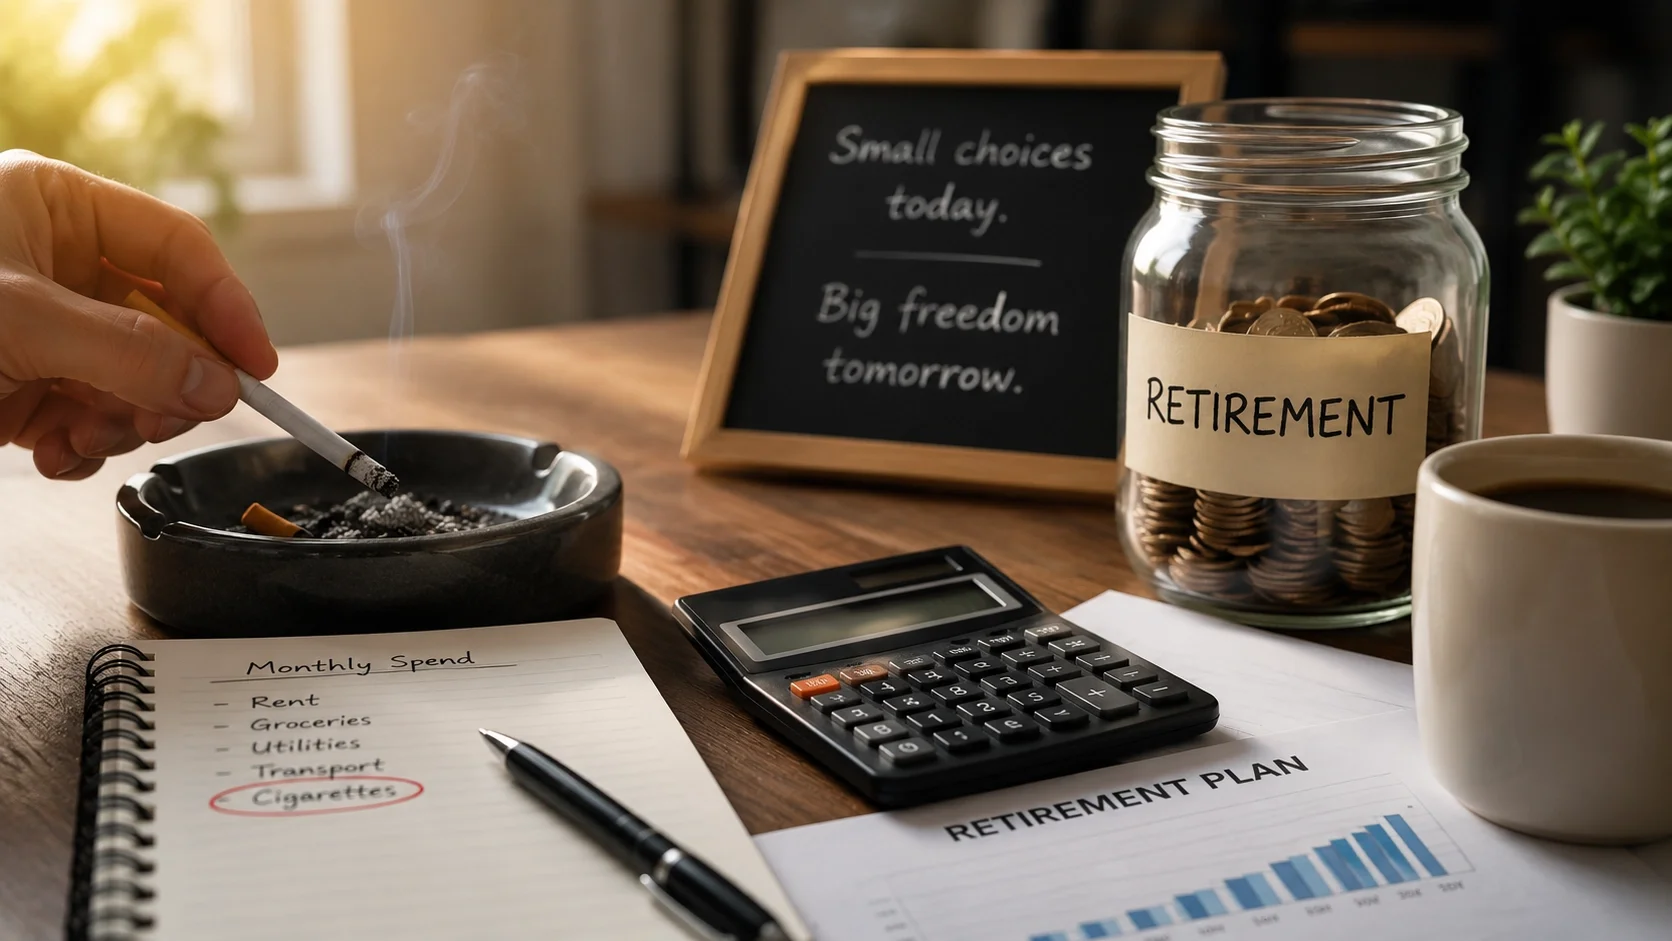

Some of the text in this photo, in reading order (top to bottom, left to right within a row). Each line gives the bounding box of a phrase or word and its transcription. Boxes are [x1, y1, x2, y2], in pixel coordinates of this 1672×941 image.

[828, 124, 1094, 171] Small choices
[886, 181, 1008, 237] today.
[816, 281, 1060, 338] Big freedom
[822, 346, 1023, 394] tomorrow.
[1147, 376, 1406, 438] RETIREMENT
[246, 651, 475, 676] Monthly Spend
[251, 694, 320, 709] Rent
[250, 715, 372, 732] Groceries
[252, 737, 361, 755] Utilities
[253, 759, 385, 780] Transport
[252, 784, 397, 811] Cigarettes
[944, 755, 1309, 842] RETIREMENT PLAN
